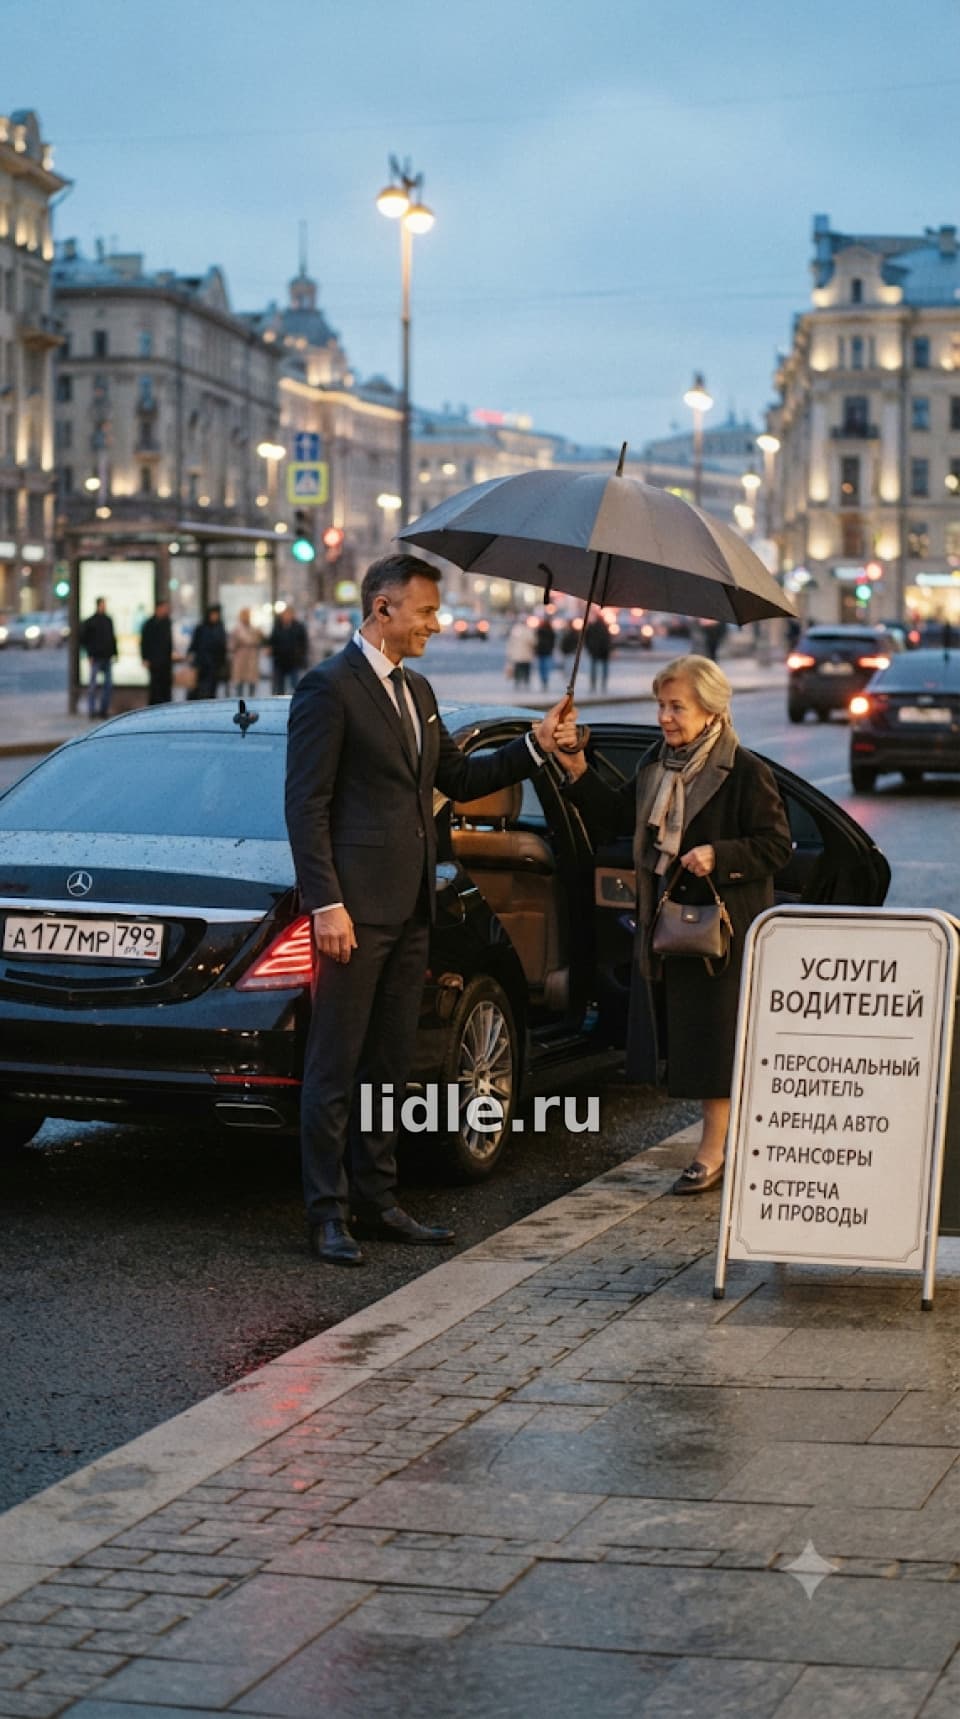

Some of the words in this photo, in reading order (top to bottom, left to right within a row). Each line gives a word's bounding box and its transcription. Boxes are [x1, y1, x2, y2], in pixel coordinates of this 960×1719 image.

[13, 922, 110, 953] А177МР
[117, 925, 155, 946] 799
[801, 957, 898, 983] УСЛУГИ
[769, 989, 924, 1020] ВОДИТЕЛЕЙ
[773, 1053, 921, 1077] ПЕРСОНАЛЬНЫЙ
[771, 1077, 864, 1098] ВОДИТЕЛЬ
[768, 1111, 838, 1134] АРЕНДА
[842, 1115, 890, 1133] АВТО
[766, 1145, 873, 1167] ТРАНСФЕРЫ
[762, 1179, 840, 1200] ВСТРЕЧА
[760, 1203, 773, 1220] И
[778, 1204, 869, 1228] ПРОВОДЫ
